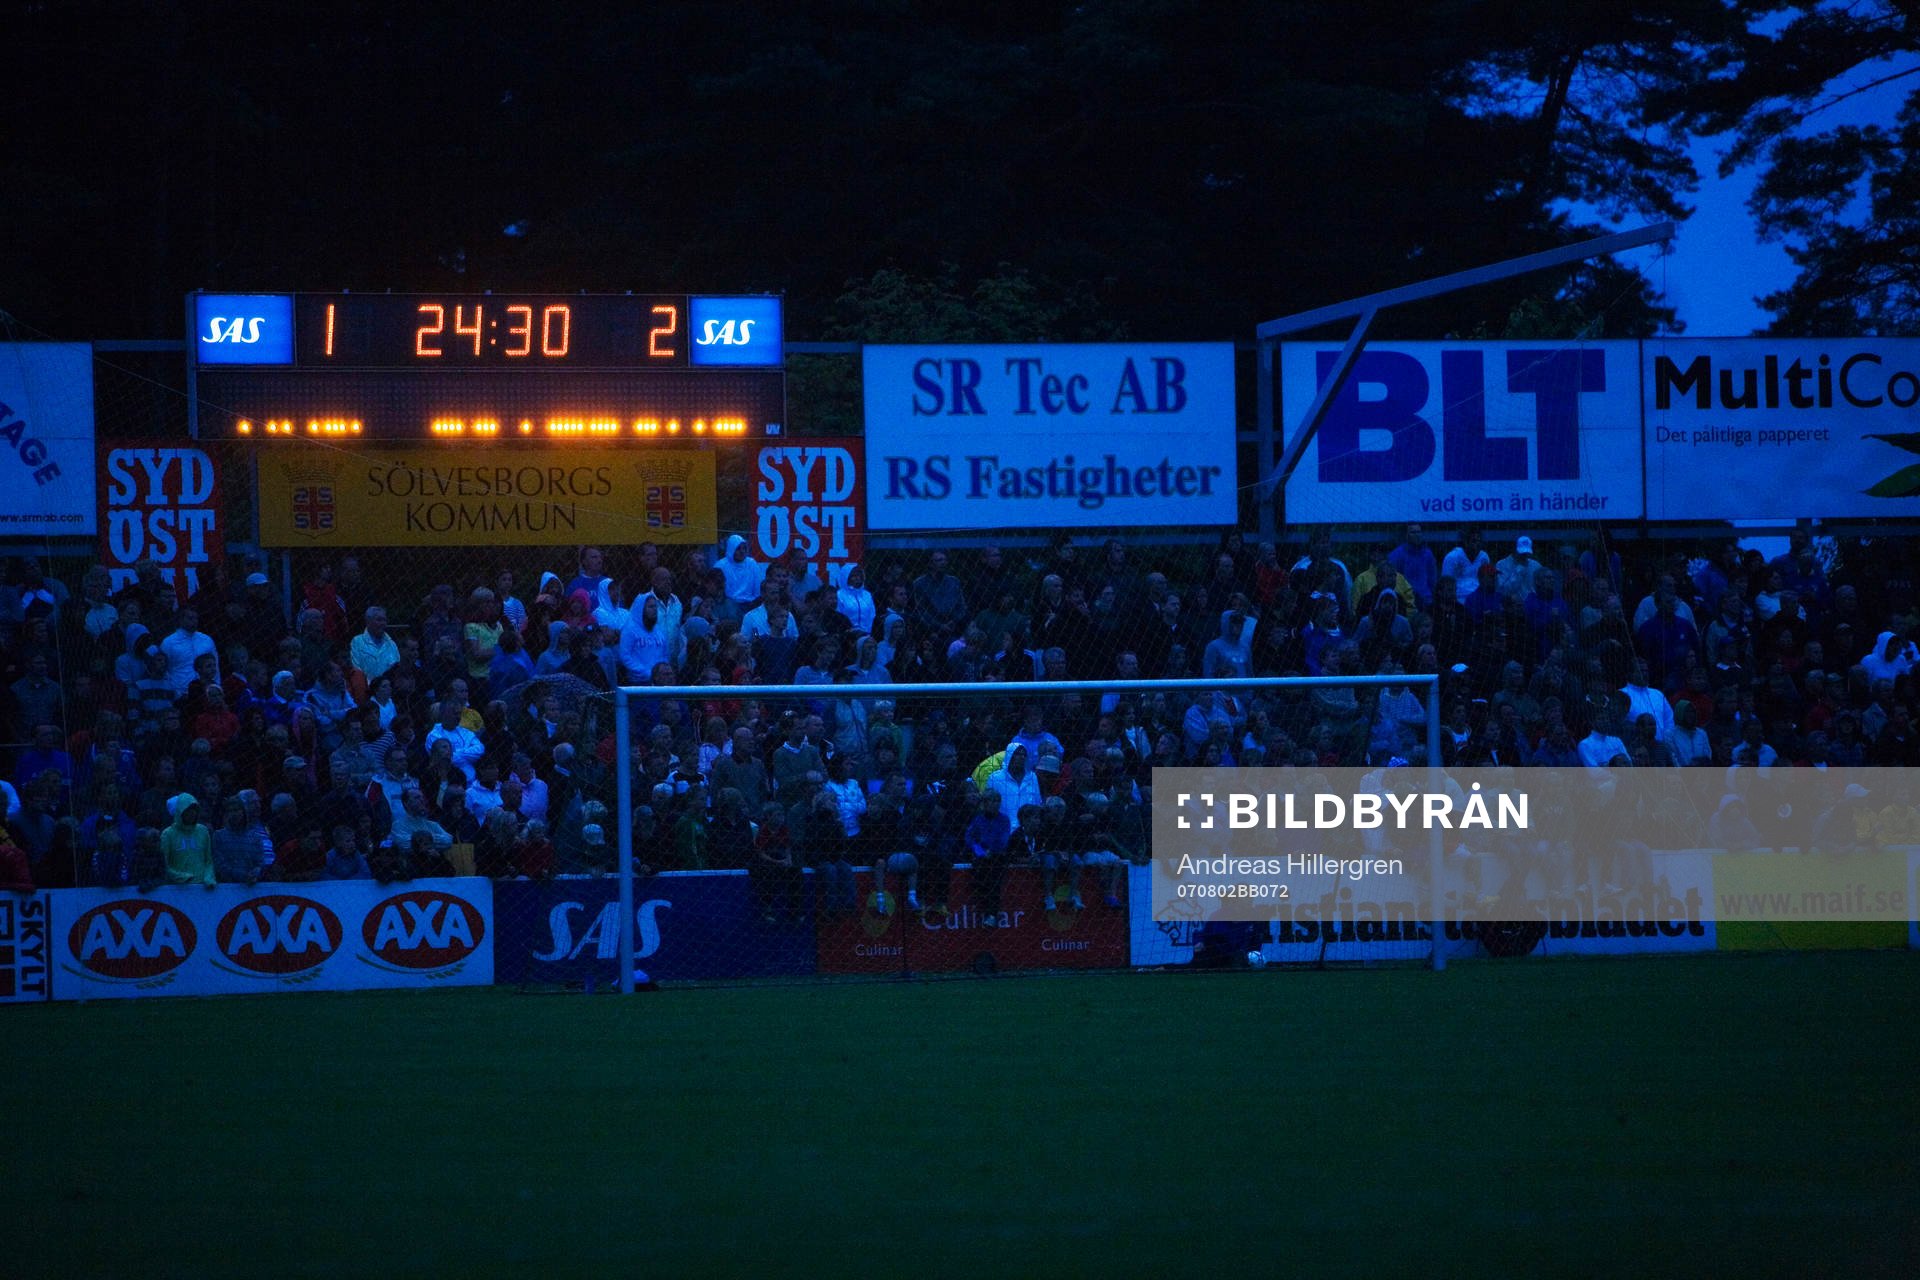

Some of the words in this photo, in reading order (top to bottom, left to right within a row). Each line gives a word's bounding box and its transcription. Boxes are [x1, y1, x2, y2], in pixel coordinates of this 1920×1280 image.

[202, 317, 266, 343] SAS
[325, 304, 335, 357] 1
[415, 304, 571, 357] 24:30
[649, 305, 677, 357] 2
[696, 319, 756, 345] SAS
[912, 357, 985, 416] SR
[1005, 357, 1089, 415] Tec
[1110, 355, 1188, 415] AB
[1316, 348, 1606, 483] BLT
[1656, 426, 1686, 443] Det
[1758, 426, 1830, 446] papperet
[107, 447, 215, 506] SYD
[368, 461, 612, 497] SÖLVESBORGS
[757, 446, 856, 502] SYD
[884, 455, 952, 500] RS
[965, 453, 1220, 510] Fastigheter
[406, 501, 576, 532] KOMMUN
[1420, 494, 1455, 513] vad
[1461, 497, 1504, 513] som
[1510, 493, 1534, 512] än
[1539, 491, 1610, 512] händer
[1719, 882, 1906, 917] www.maif.se
[20, 897, 45, 996] SKYLT
[79, 908, 187, 960] AXA
[227, 904, 332, 955] AXA
[372, 900, 475, 951] AXA
[533, 900, 672, 962] SAS
